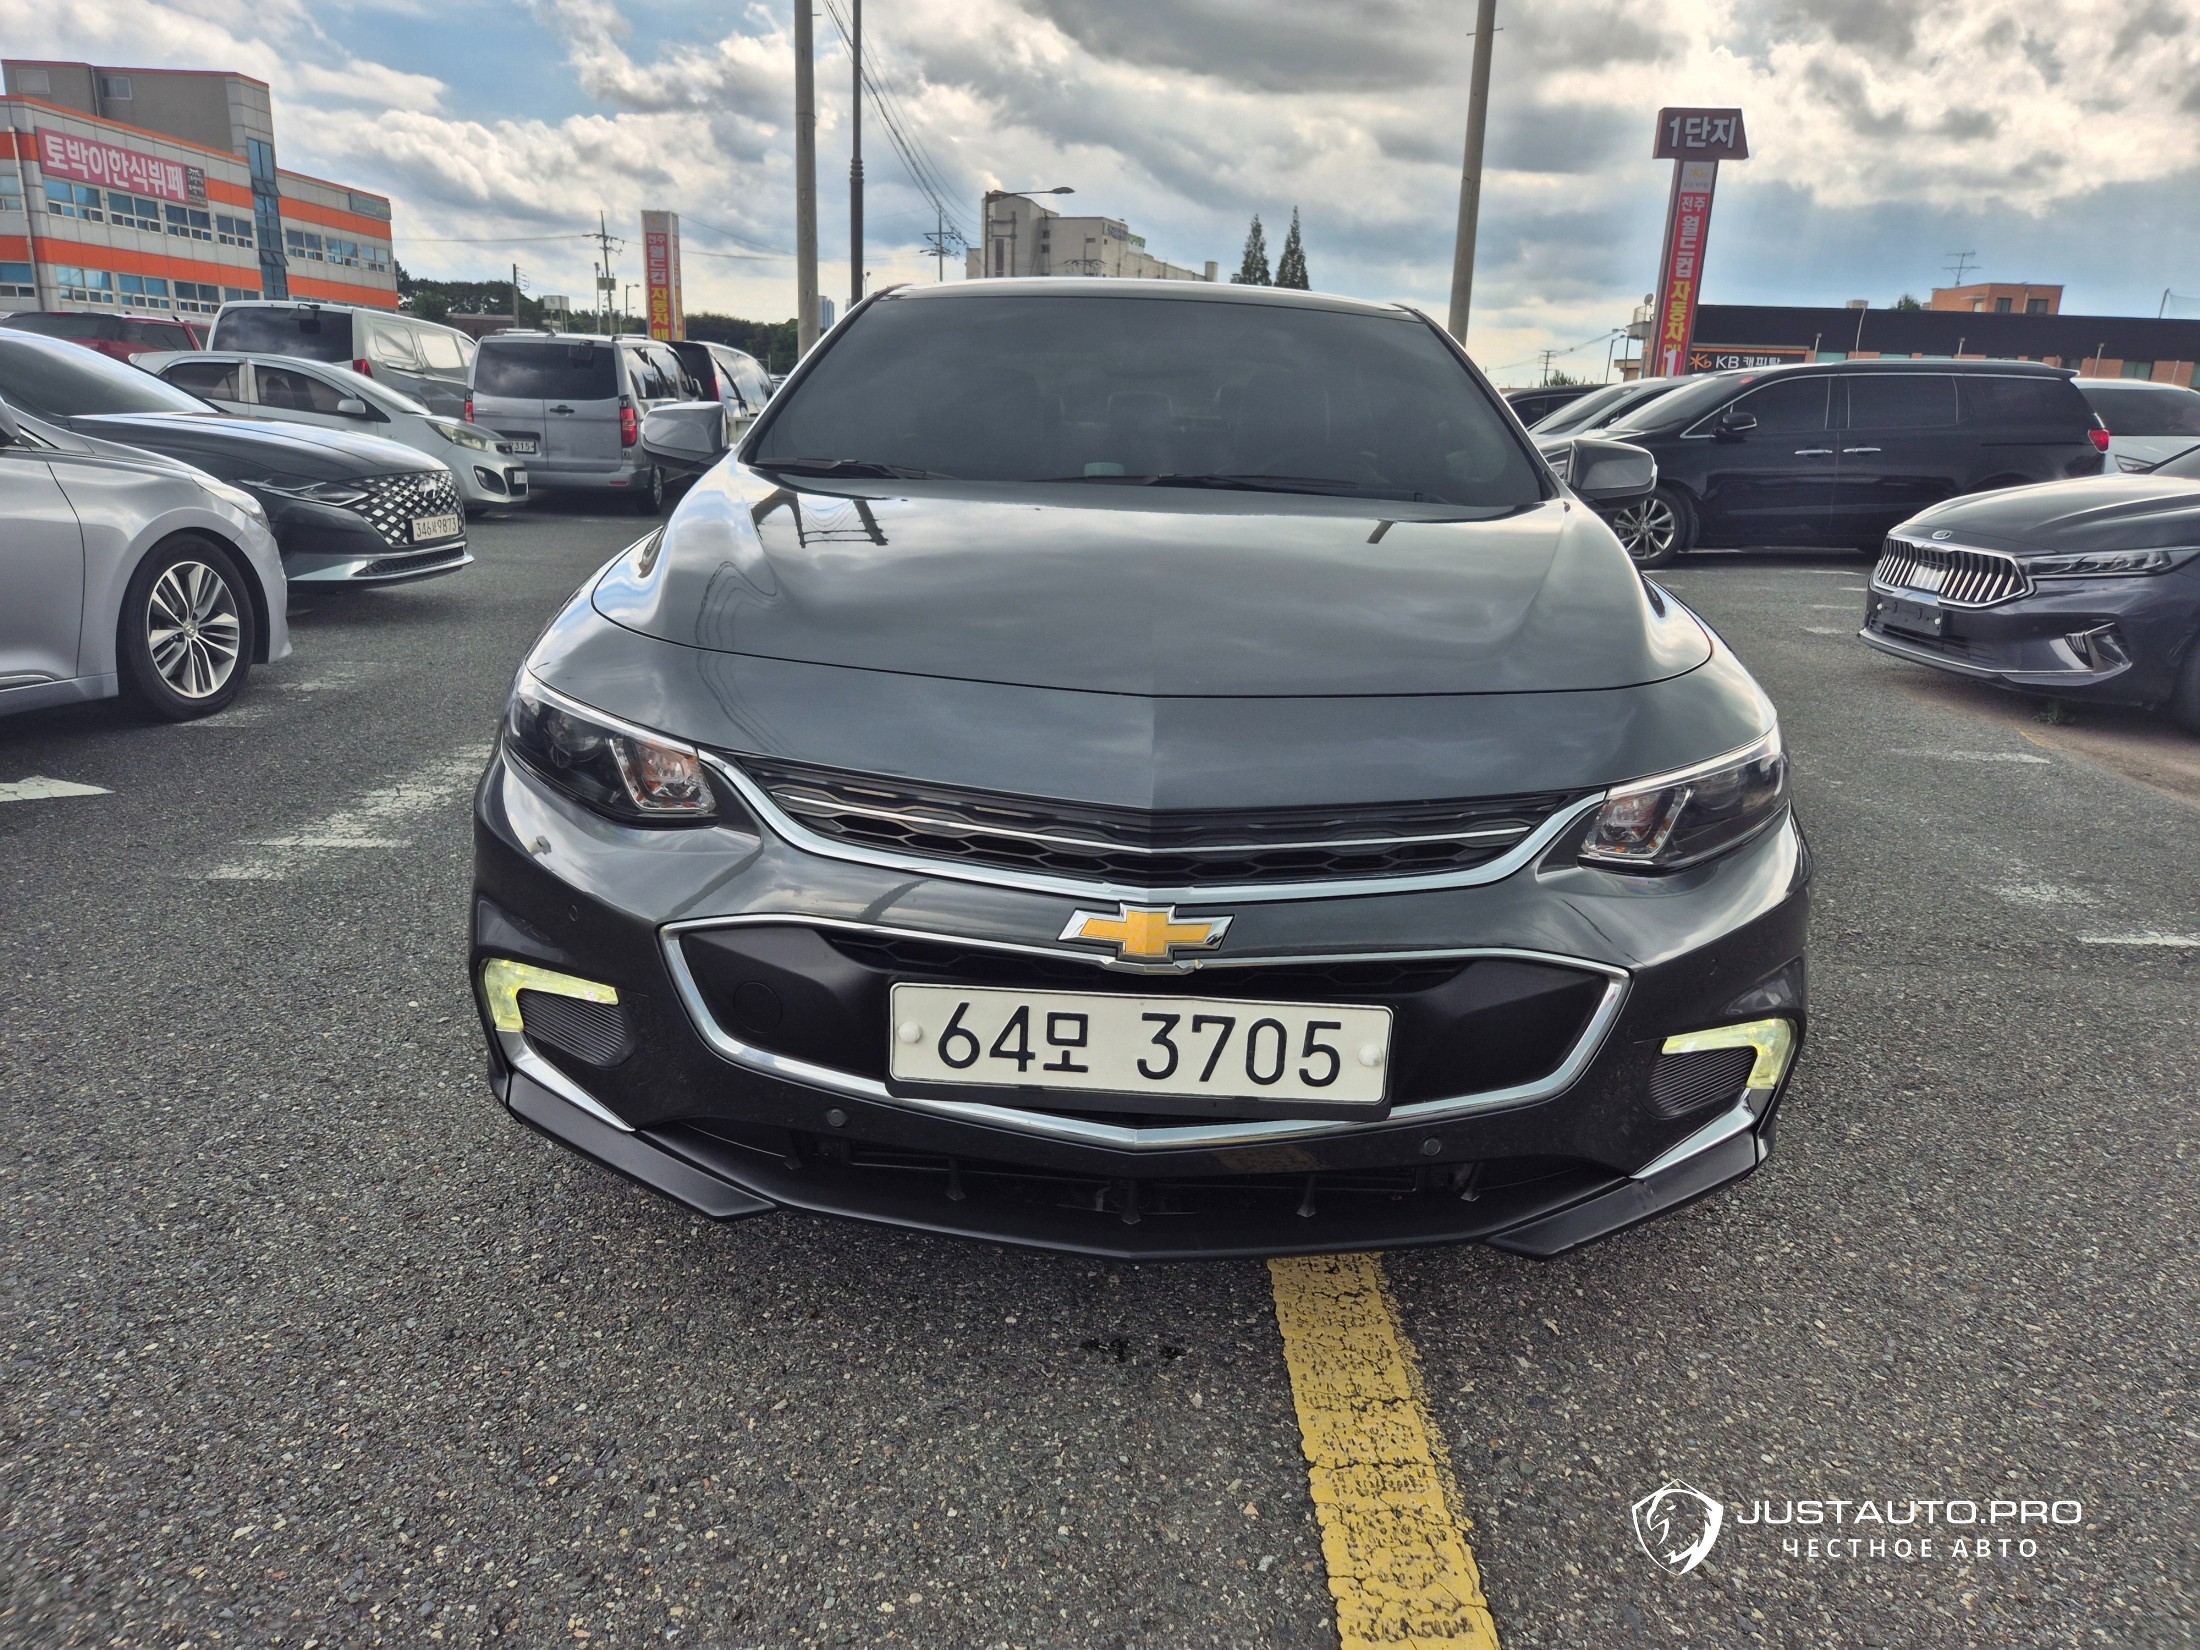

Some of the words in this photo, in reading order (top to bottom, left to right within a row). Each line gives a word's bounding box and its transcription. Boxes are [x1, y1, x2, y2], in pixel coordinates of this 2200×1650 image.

[1669, 116, 1737, 149] 1단지
[45, 134, 186, 200] 토박이한식뷔페
[1681, 196, 1706, 213] 전주
[1665, 281, 1691, 342] 자동차
[1715, 355, 1740, 369] KB
[937, 1002, 1089, 1073] 64모
[1136, 1012, 1342, 1087] 3705
